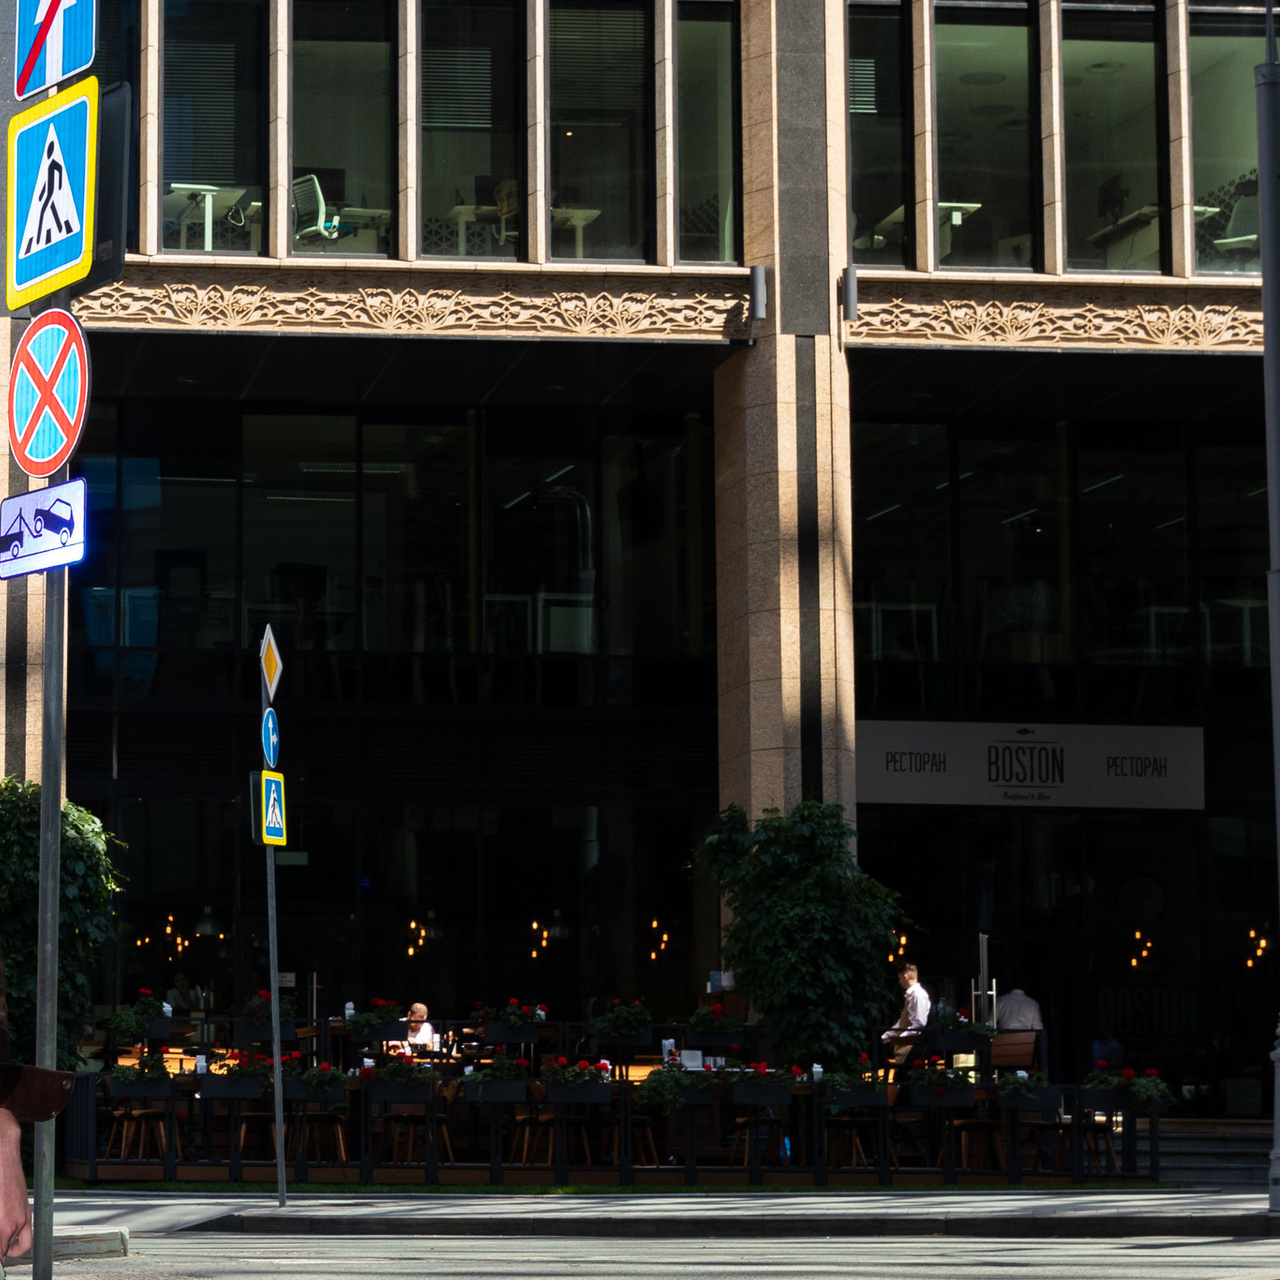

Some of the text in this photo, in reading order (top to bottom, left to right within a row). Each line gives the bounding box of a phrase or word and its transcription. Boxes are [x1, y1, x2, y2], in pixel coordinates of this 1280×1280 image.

[885, 751, 946, 773] РЕСТОРАН
[987, 745, 1065, 784] BOSTON
[1106, 756, 1168, 778] РЕСТОРАН
[1097, 986, 1199, 1037] BOSTON
